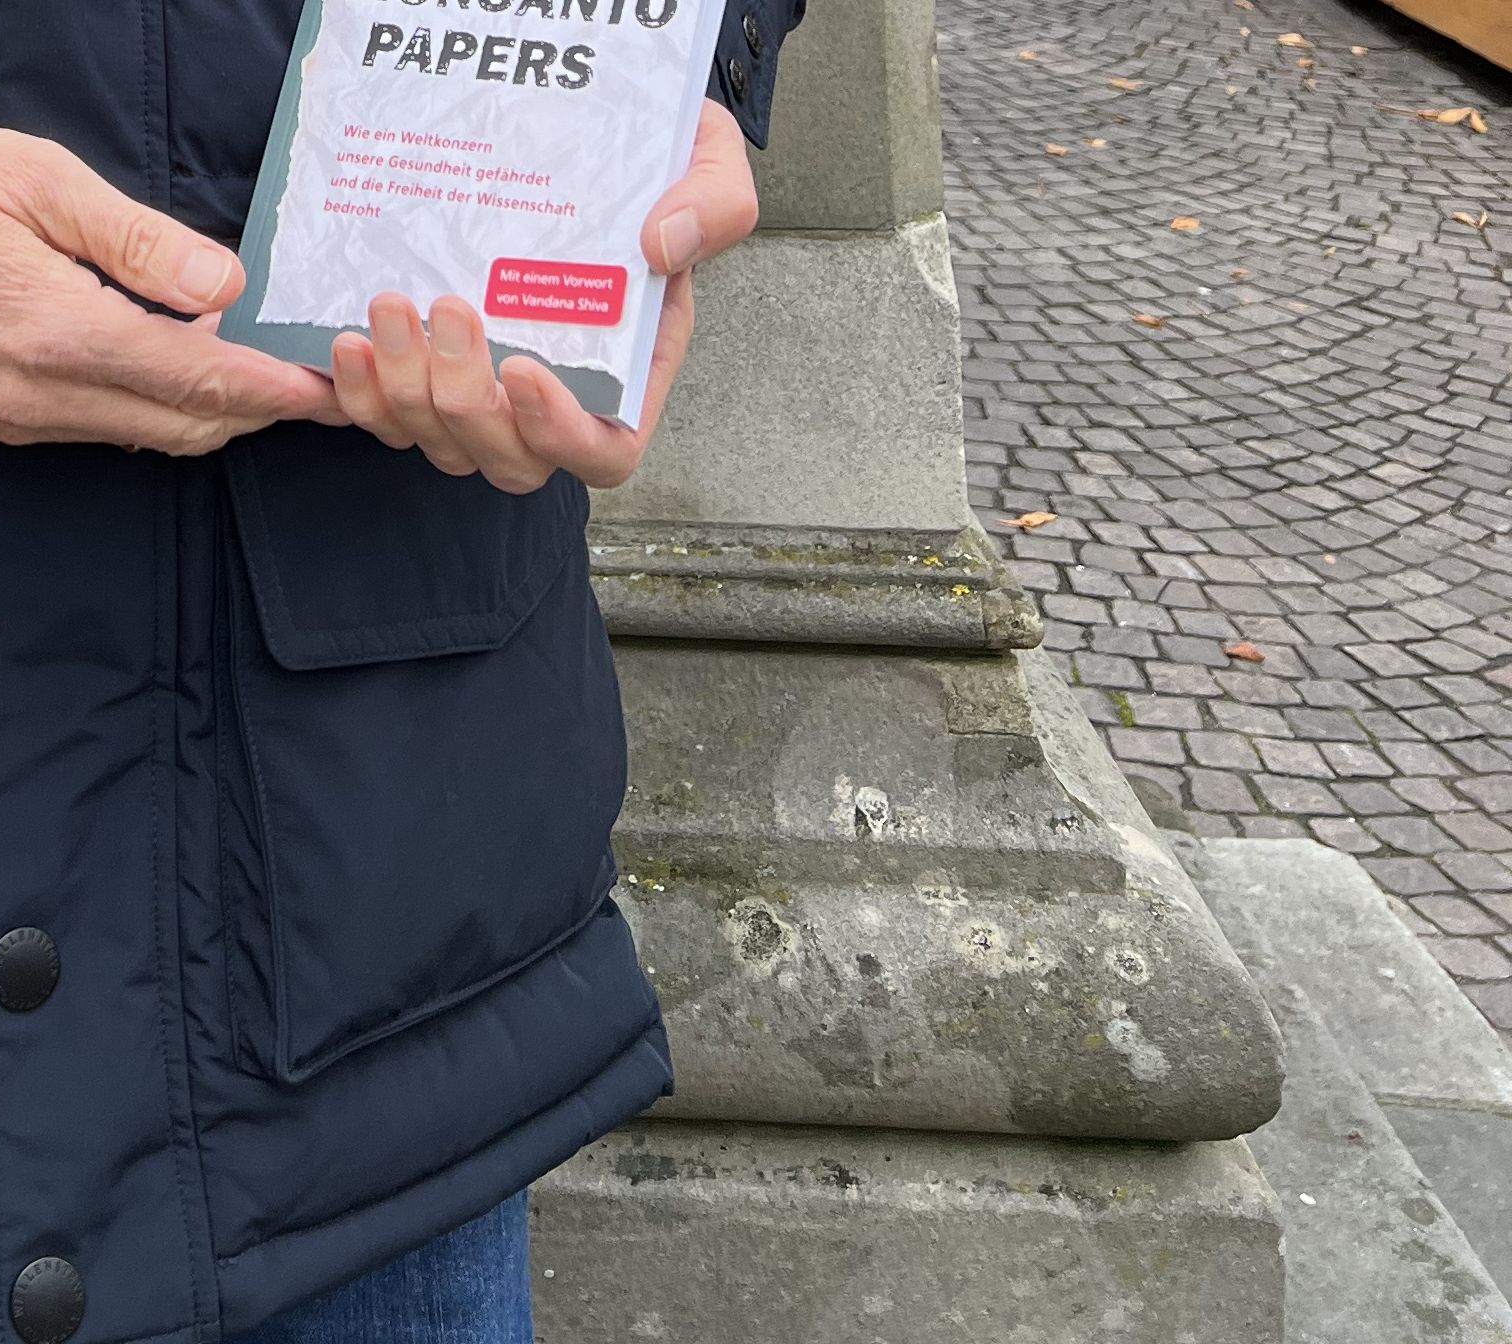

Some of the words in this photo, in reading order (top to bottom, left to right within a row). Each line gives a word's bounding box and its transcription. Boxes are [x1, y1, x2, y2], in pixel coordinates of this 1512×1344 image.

[361, 21, 597, 90] PAPERS
[344, 123, 370, 140] Wie
[374, 128, 396, 143] ein
[401, 131, 493, 154] Weltkonzern
[336, 151, 384, 167] unsere
[388, 155, 472, 177] Gesundheit
[475, 166, 552, 187] gefährdet
[323, 197, 381, 218] bedroht
[330, 175, 358, 189] und
[361, 177, 383, 193] die
[387, 180, 443, 200] Freiheit
[447, 188, 472, 204] der
[476, 192, 576, 217] Wissenschaft
[499, 269, 521, 283] Mit
[522, 271, 560, 286] einem
[563, 274, 613, 290] Vorwort
[496, 293, 519, 305] von
[522, 293, 574, 310] Vandana
[577, 296, 609, 313] Shiva
